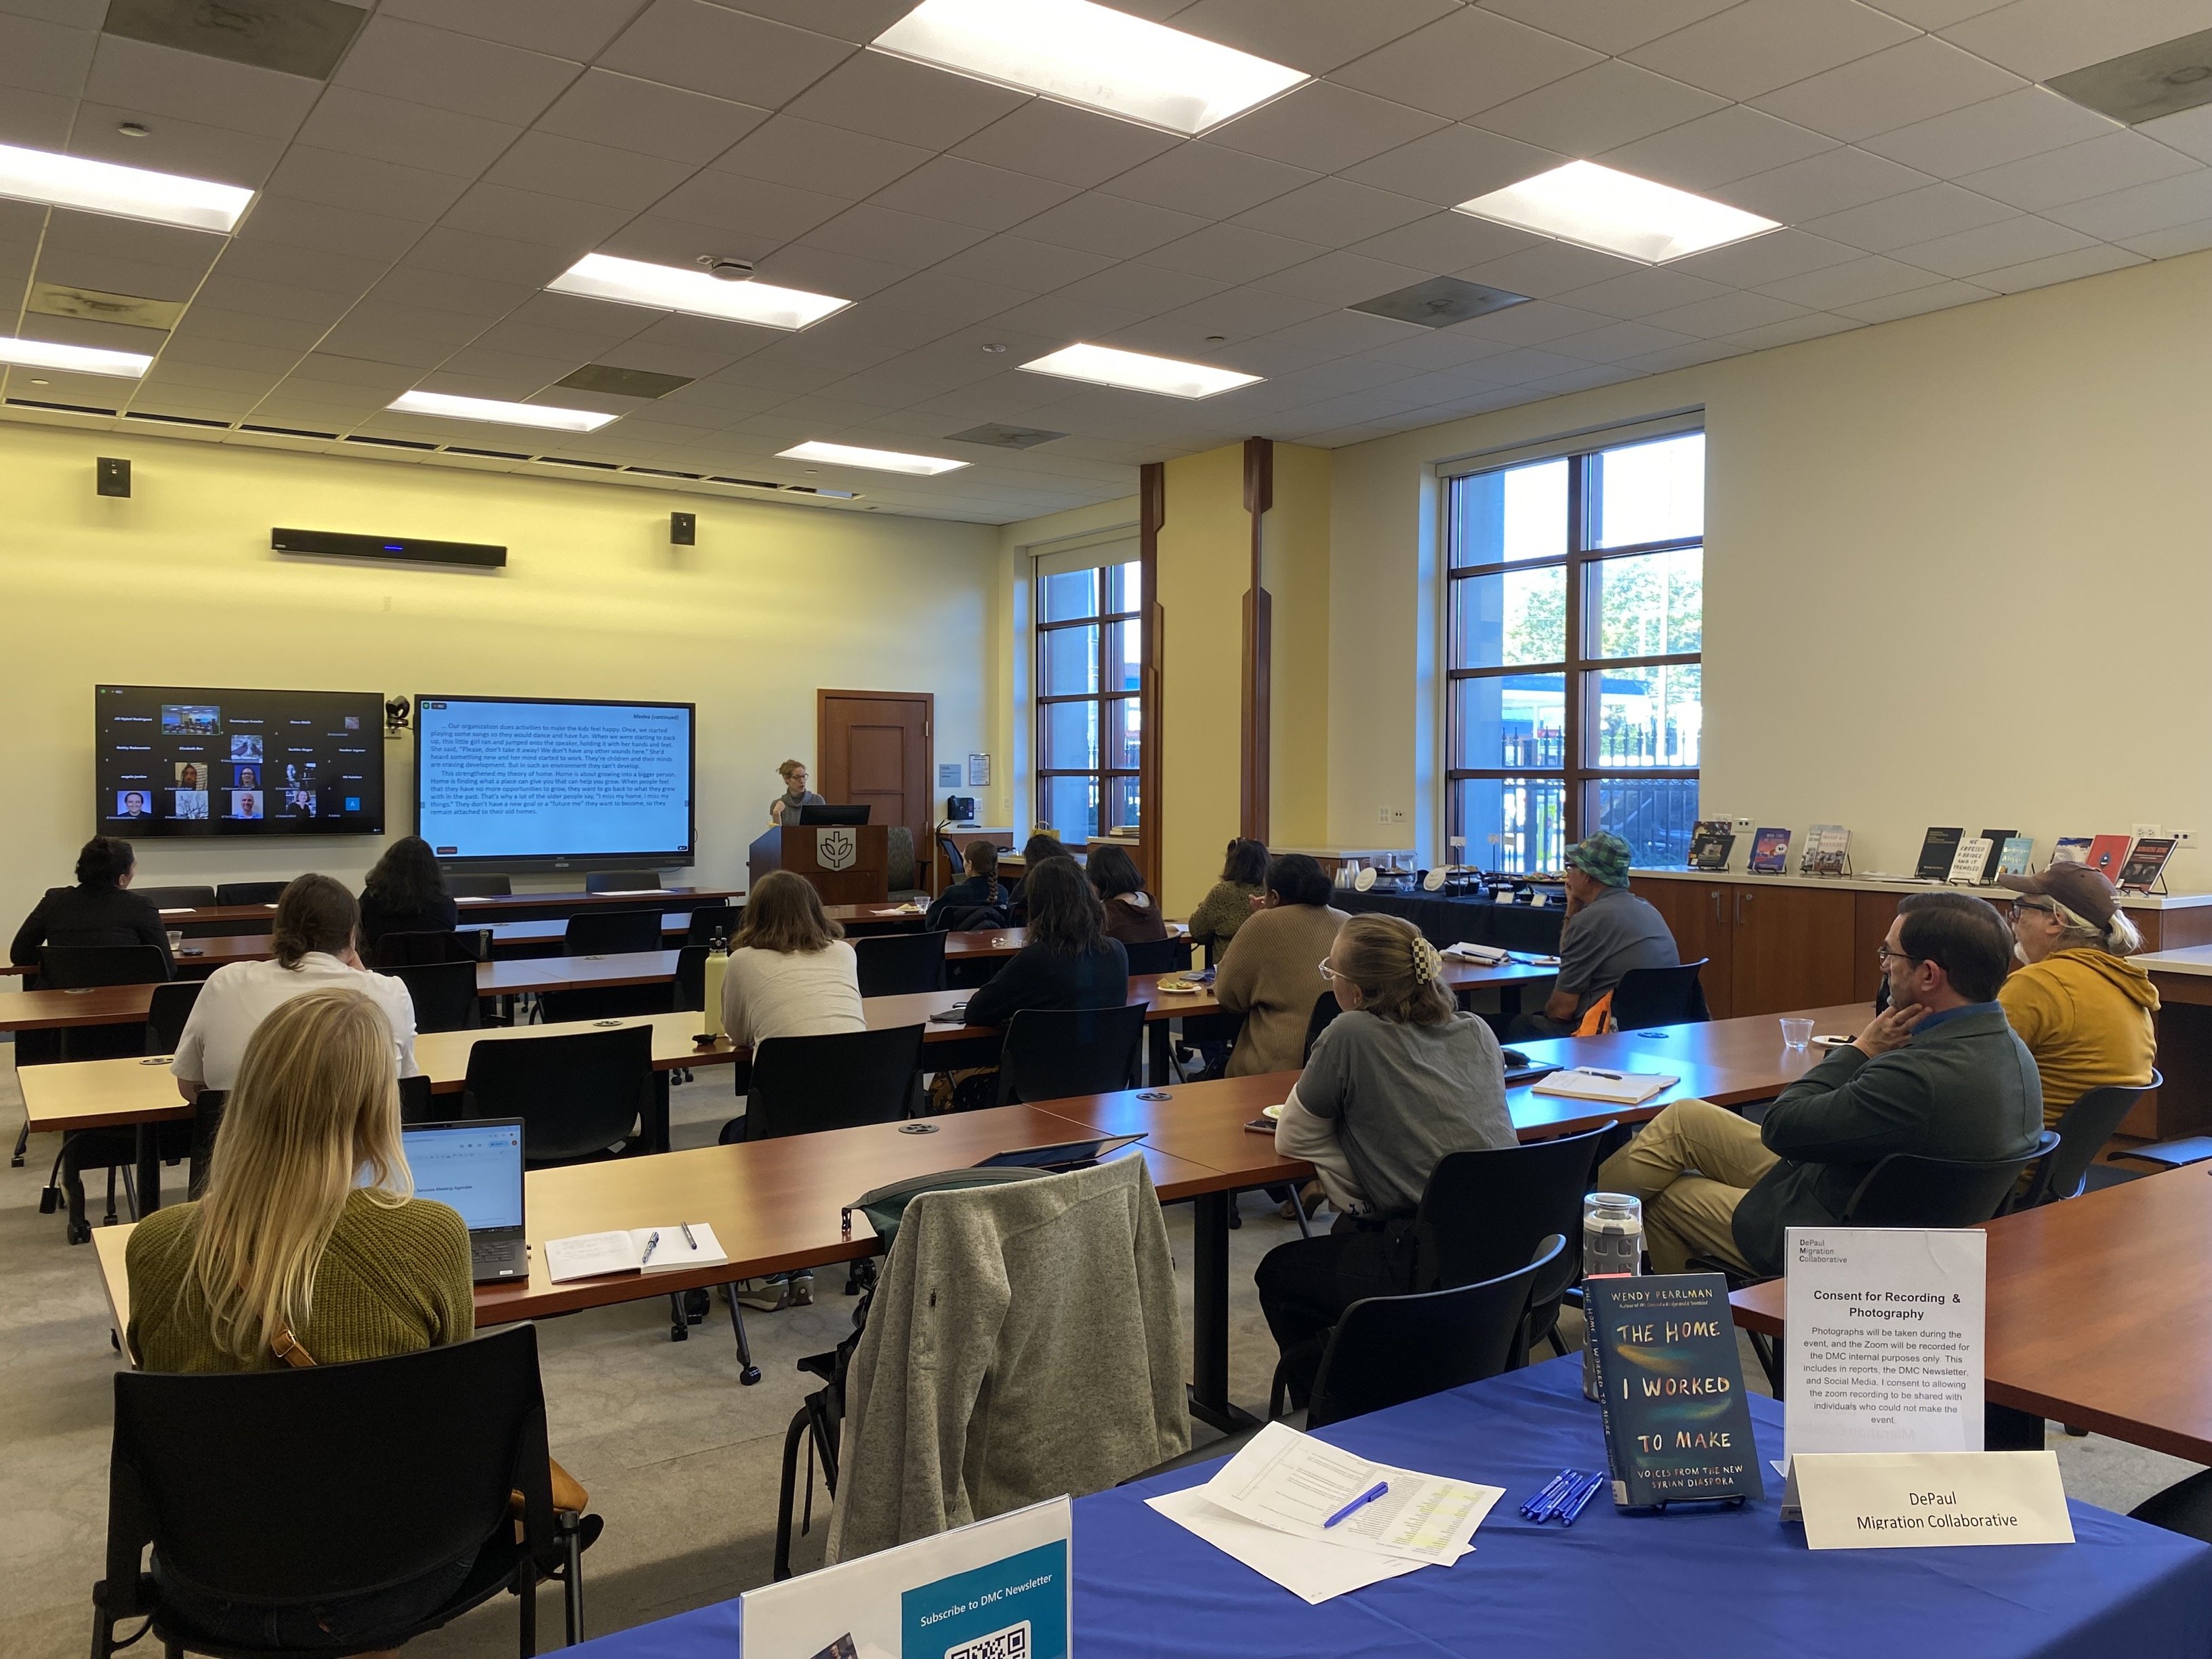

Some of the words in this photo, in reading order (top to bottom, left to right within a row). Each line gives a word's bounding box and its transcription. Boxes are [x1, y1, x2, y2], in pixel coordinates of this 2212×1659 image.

[1799, 1247, 1834, 1256] Migration
[1611, 1291, 1650, 1301] WENDY
[1656, 1289, 1713, 1299] PEARLMAN
[1814, 1290, 1862, 1300] Consent
[1865, 1291, 1881, 1300] for
[1885, 1292, 1944, 1305] Recording
[1952, 1294, 1961, 1303] &
[1849, 1307, 1924, 1320] Photography
[1616, 1323, 1655, 1344] THE
[1666, 1320, 1721, 1344] HOME
[1811, 1327, 1864, 1336] Photographs
[1881, 1328, 1892, 1336] be
[1919, 1330, 1946, 1339] during
[1948, 1330, 1961, 1338] the
[1803, 1340, 1828, 1348] event,
[1849, 1340, 1862, 1348] the
[1906, 1341, 1917, 1349] be
[1959, 1343, 1970, 1351] for
[1810, 1351, 1823, 1359] the
[1825, 1351, 1846, 1360] DMC
[1849, 1352, 1879, 1361] internal
[1881, 1355, 1920, 1363] purposes
[1944, 1355, 1963, 1363] This
[1803, 1364, 1837, 1372] includes
[1849, 1366, 1880, 1374] reports,
[1883, 1366, 1896, 1374] the
[1898, 1366, 1920, 1374] DMC
[1922, 1367, 1968, 1376] Newsletter,
[1623, 1378, 1629, 1400] I
[1642, 1376, 1730, 1397] WORKED
[1805, 1376, 1821, 1385] and
[1824, 1376, 1849, 1385] Social
[1851, 1377, 1879, 1385] Media.
[1932, 1380, 1966, 1390] allowing
[1809, 1389, 1822, 1397] the
[1849, 1390, 1888, 1400] recording
[1914, 1392, 1942, 1400] shared
[1814, 1401, 1856, 1410] individuals
[1944, 1405, 1957, 1413] the
[1637, 1433, 1662, 1453] TO
[1675, 1431, 1732, 1449] MAKE
[1637, 1469, 1671, 1479] VOICES
[1675, 1467, 1700, 1477] FROM
[1702, 1467, 1720, 1475] THE
[1723, 1464, 1744, 1474] NEW
[1652, 1478, 1683, 1489] SYRIAN
[1687, 1477, 1734, 1488] DIASPORA
[1909, 1490, 1956, 1505] DePaul
[1857, 1515, 1924, 1530] Migration
[1927, 1513, 2018, 1528] Collaborative
[920, 1605, 966, 1626] Subscribe
[968, 1601, 978, 1610] to
[981, 1589, 1002, 1606] DMC
[1005, 1574, 1052, 1597] Newsletter
